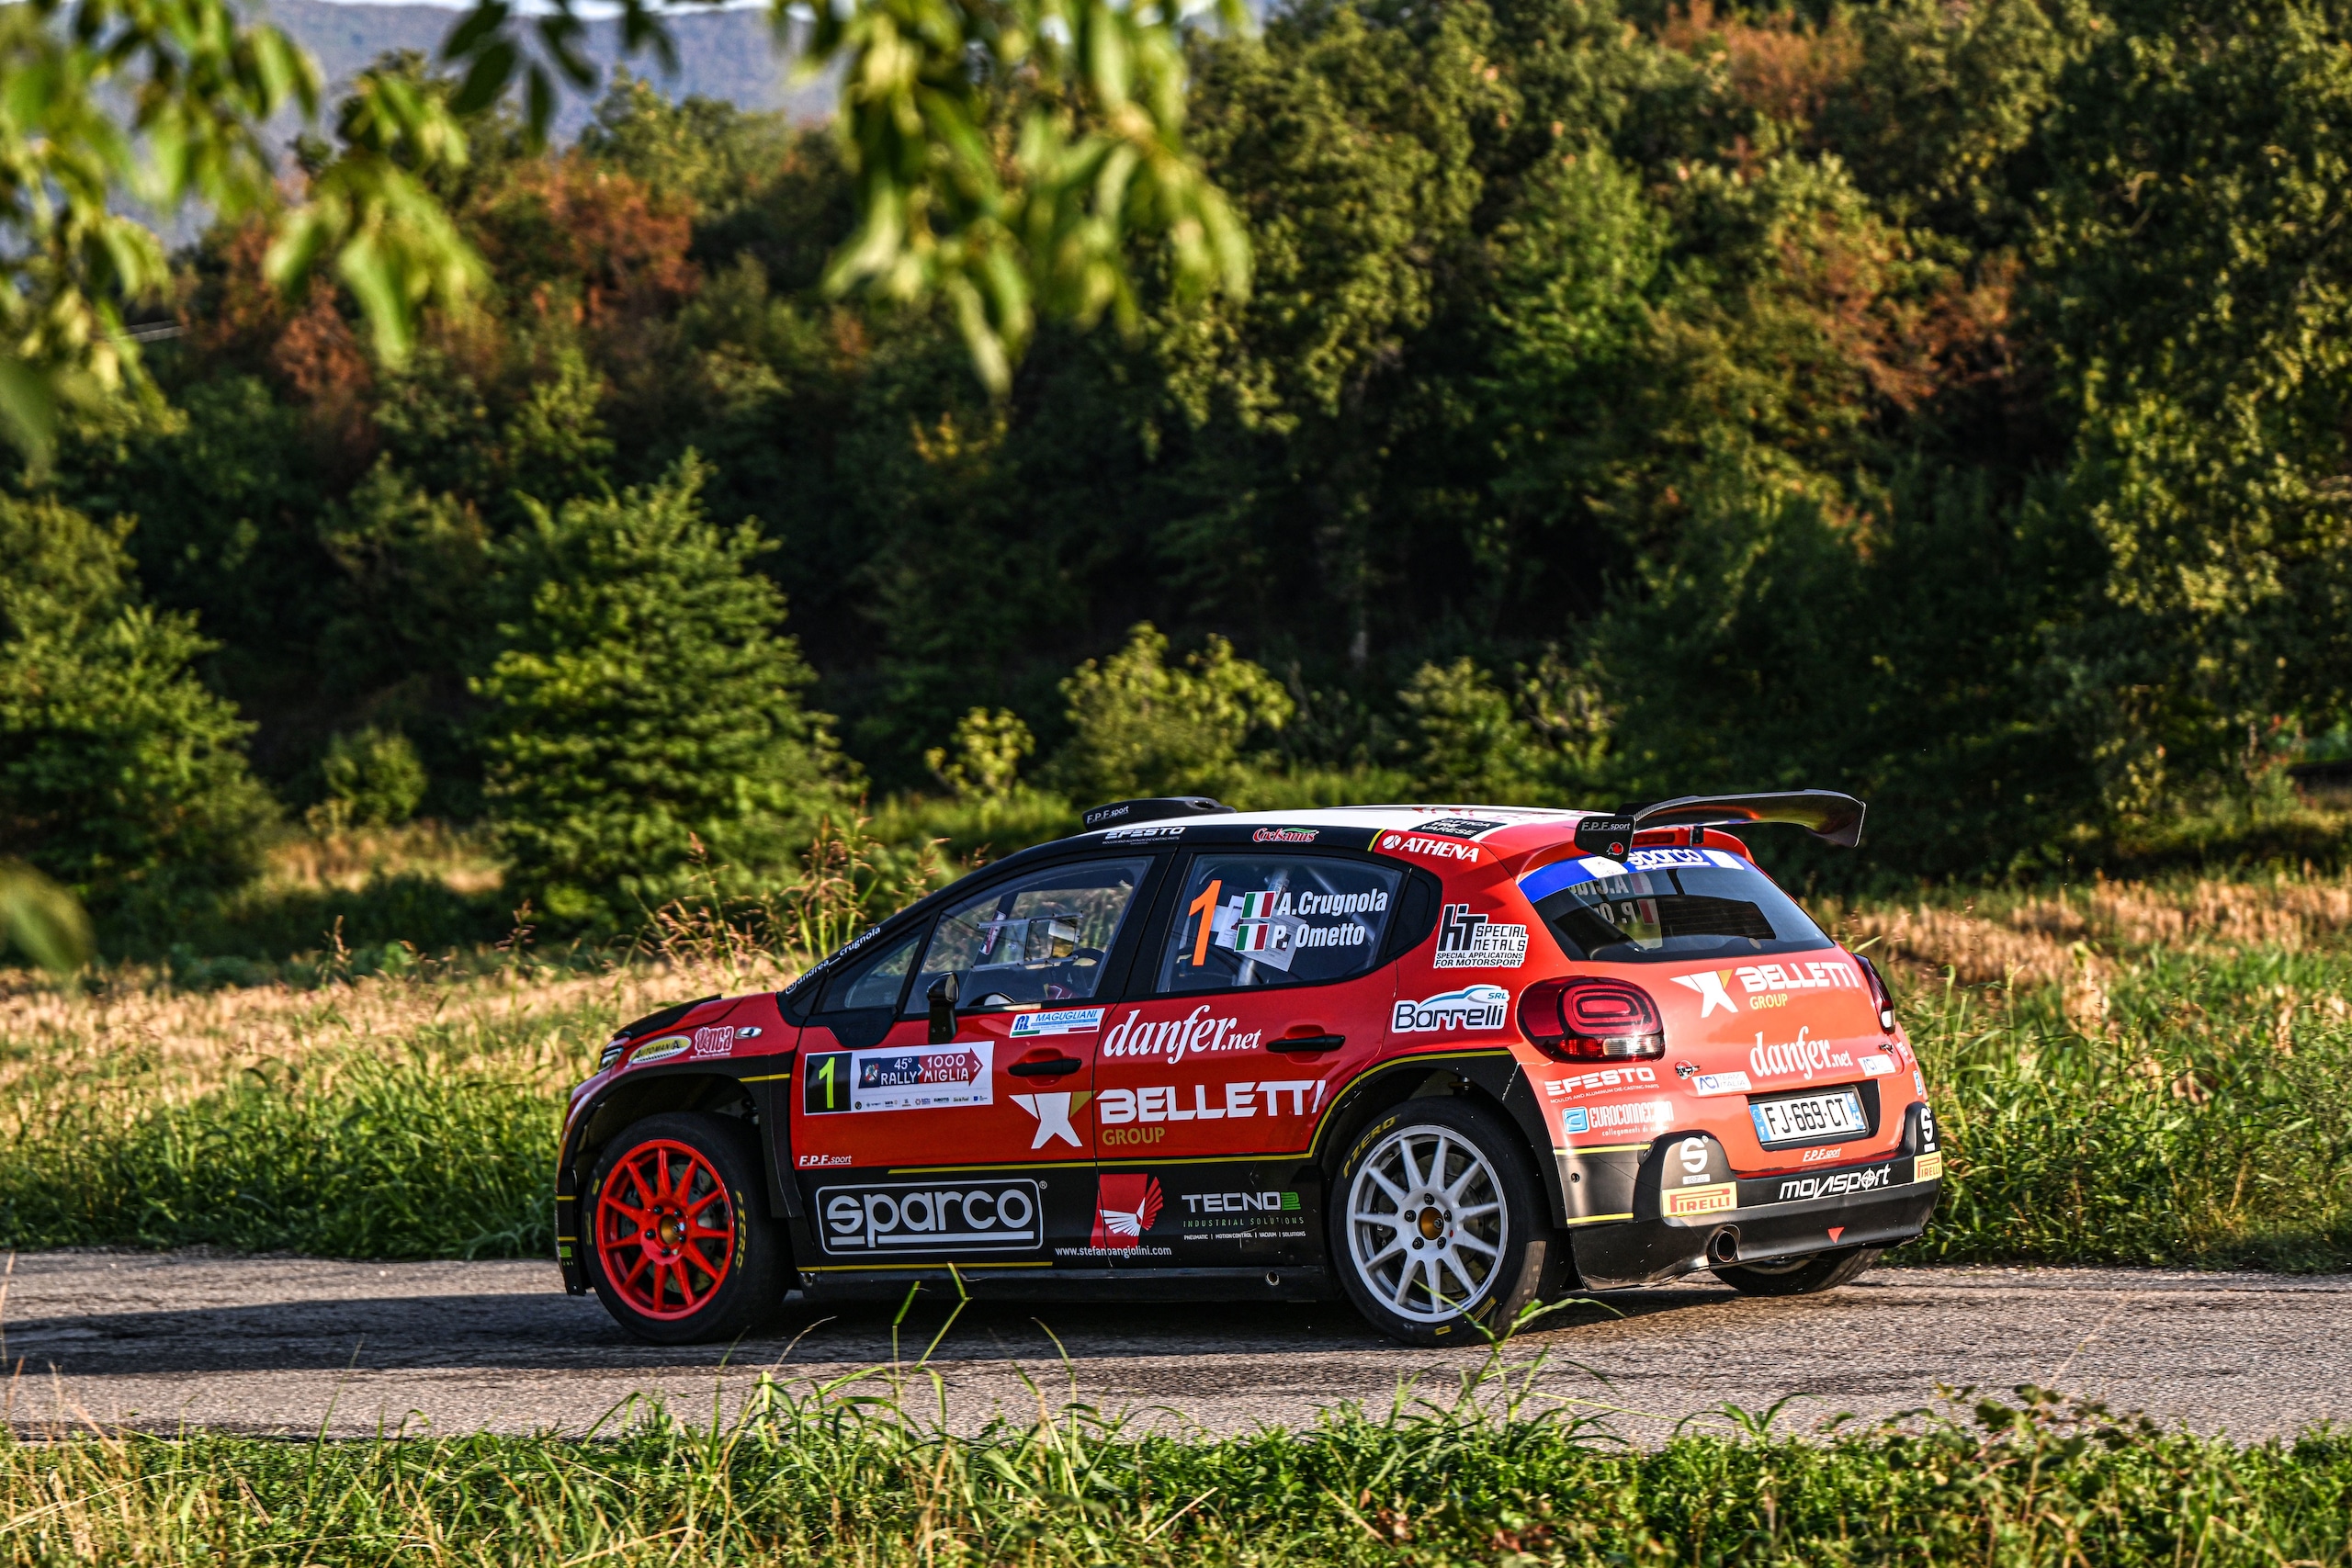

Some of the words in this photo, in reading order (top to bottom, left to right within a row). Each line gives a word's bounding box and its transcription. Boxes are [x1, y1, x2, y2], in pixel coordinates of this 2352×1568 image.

[1105, 827, 1185, 840] EFESTO
[1399, 837, 1480, 863] ATHENA
[1628, 848, 1704, 869] sparco
[1277, 888, 1389, 916] A.Crugnola
[1188, 879, 1223, 966] 1
[1476, 925, 1527, 938] SPECIAL
[1272, 924, 1288, 949] P.
[1295, 922, 1366, 948] Ometto
[1474, 940, 1526, 952] METALS
[1435, 959, 1454, 967] FOR
[1736, 962, 1860, 993] BELLETTI
[1749, 993, 1789, 1010] GROUP
[1035, 1010, 1098, 1022] MAGUGLIANI
[1395, 1003, 1504, 1029] Borrelli
[1102, 1004, 1262, 1065] danfer.net
[927, 1055, 966, 1068] 1000
[1749, 1025, 1854, 1079] danfer.net
[818, 1056, 836, 1109] 1
[880, 1071, 917, 1086] RALLY
[923, 1068, 969, 1082] MIGLIA
[1544, 1066, 1657, 1097] EFESTO
[1096, 1079, 1327, 1124] BELLETTI
[1102, 1126, 1166, 1145] GROUP
[1917, 1156, 1940, 1179] PIRELLI
[1670, 1188, 1731, 1213] PIRELLI
[827, 1189, 1034, 1247] sparco
[1183, 1218, 1244, 1228] INDUSTRIAL
[1250, 1216, 1305, 1225] SOLUTIONS
